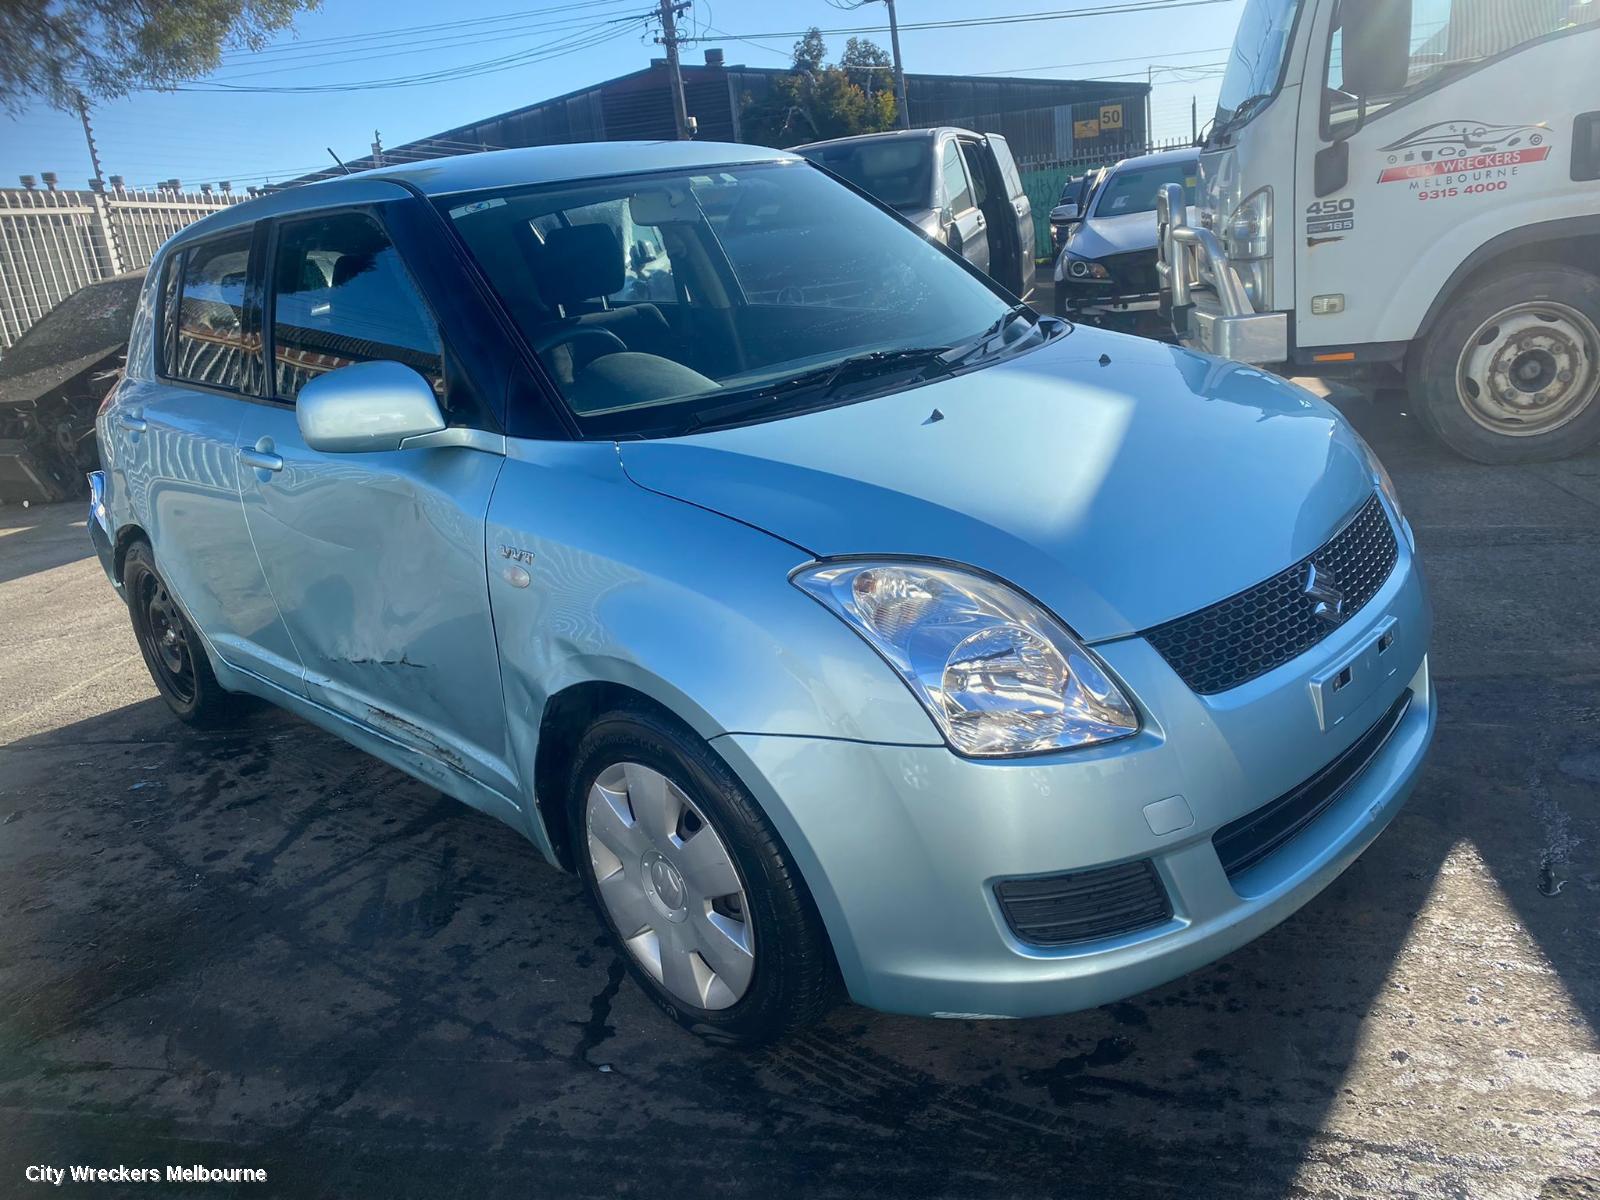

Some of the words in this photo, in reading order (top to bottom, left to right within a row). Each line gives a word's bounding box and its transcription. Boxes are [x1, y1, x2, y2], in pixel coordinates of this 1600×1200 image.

[1102, 110, 1120, 124] 50
[1406, 164, 1438, 178] CITY
[1442, 150, 1521, 172] WRECKERS
[1408, 166, 1519, 190] MELBOURNE
[1418, 187, 1458, 201] 9315
[1463, 180, 1508, 195] 4000
[1306, 198, 1354, 215] 450
[499, 543, 536, 566] VVT
